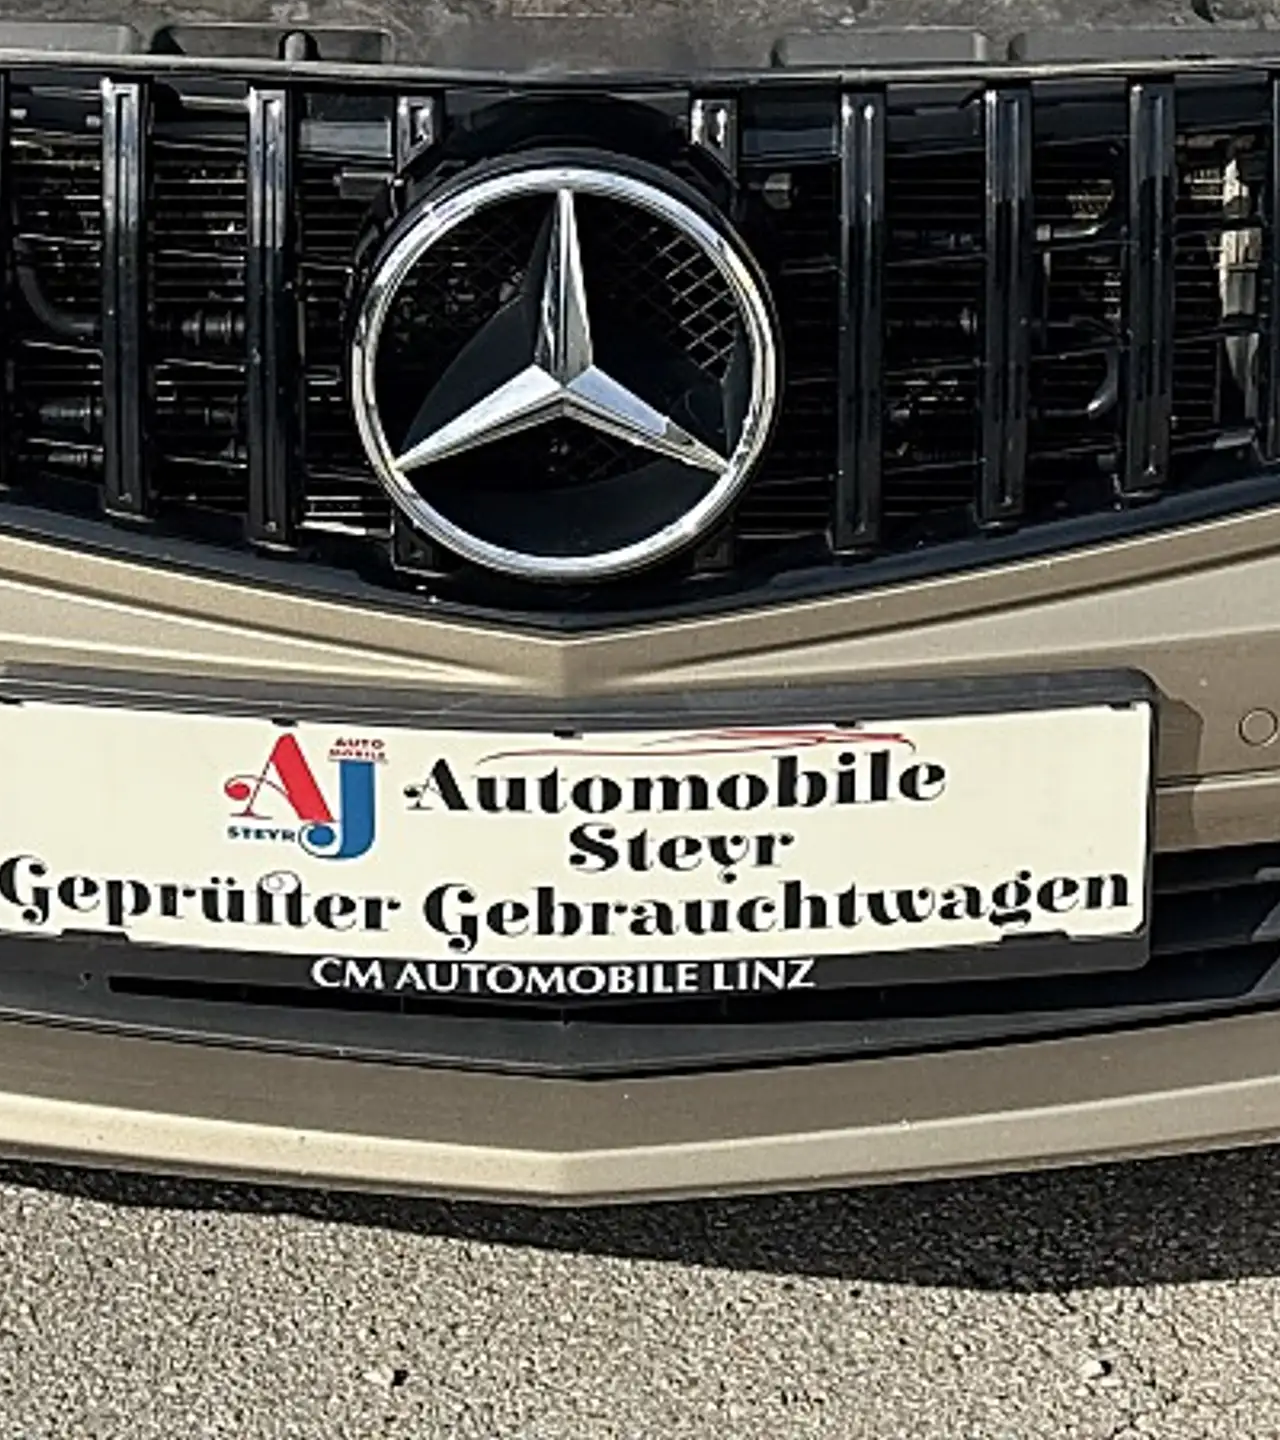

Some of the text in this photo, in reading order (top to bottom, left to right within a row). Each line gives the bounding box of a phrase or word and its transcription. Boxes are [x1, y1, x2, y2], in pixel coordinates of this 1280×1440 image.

[334, 736, 386, 749] AUTO
[403, 749, 946, 814] Automobile
[227, 826, 296, 841] STEYR
[568, 822, 795, 884] Steyr
[423, 870, 1131, 953] Gebrauchtwagen
[311, 957, 816, 994] CM AUTOMOBILE LINZ
